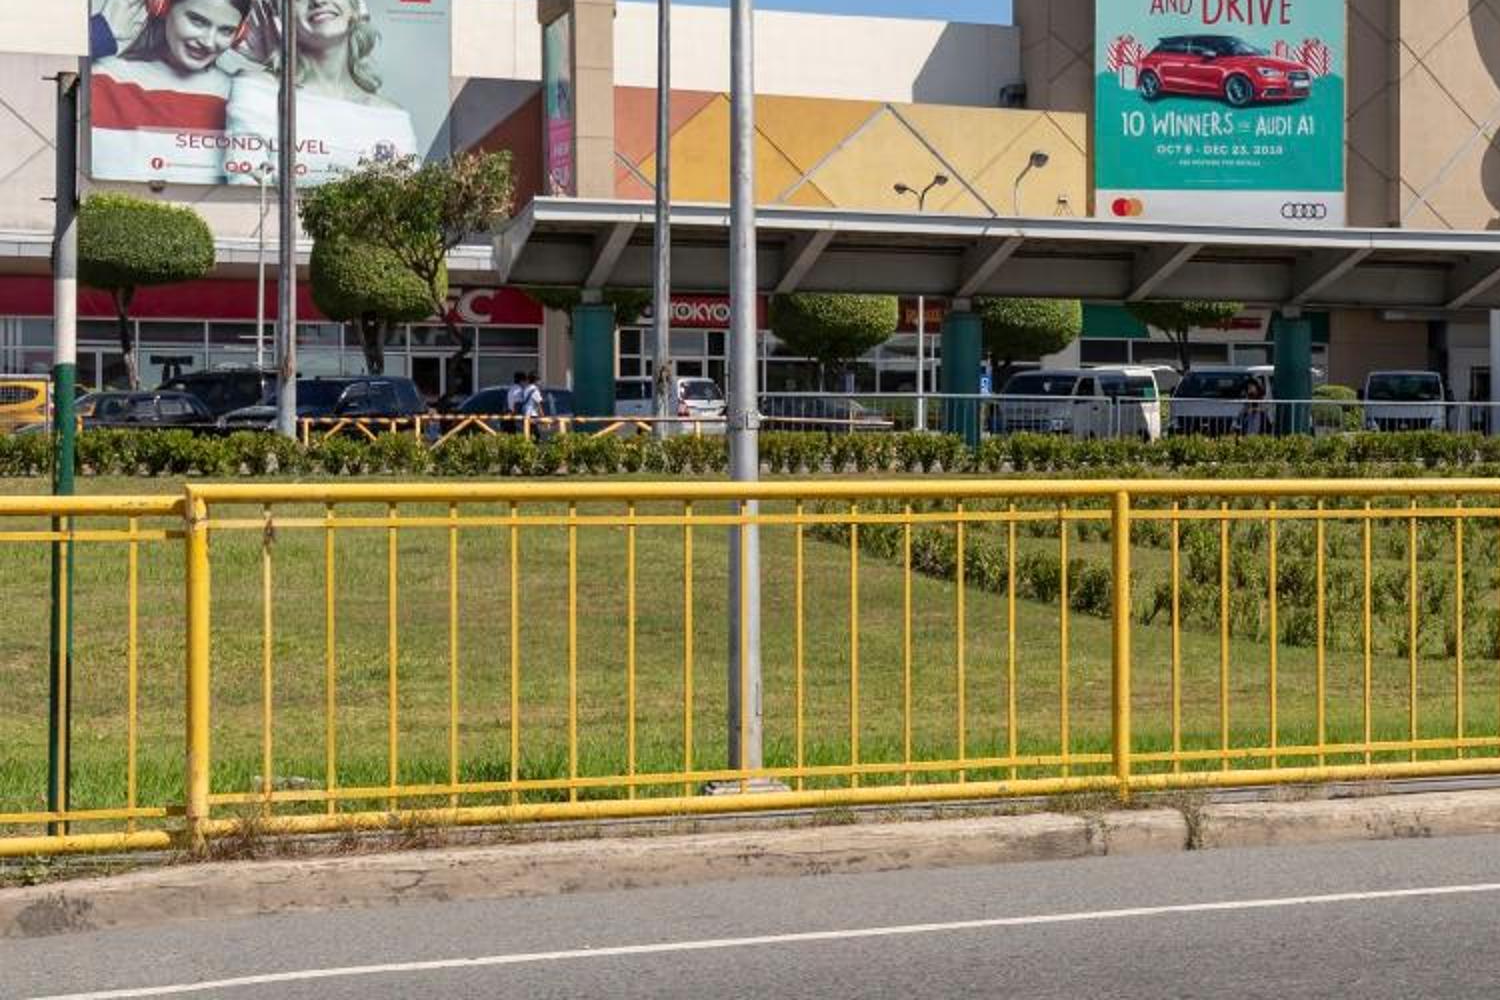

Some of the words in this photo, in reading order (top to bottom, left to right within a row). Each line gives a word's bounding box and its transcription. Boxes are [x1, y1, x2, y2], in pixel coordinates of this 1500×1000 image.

[1121, 110, 1146, 137] 10
[1152, 110, 1234, 137] WINNERS
[1255, 114, 1292, 137] AUDI
[1297, 113, 1315, 137] A1
[175, 132, 264, 151] SECOND
[269, 136, 330, 155] LVEL
